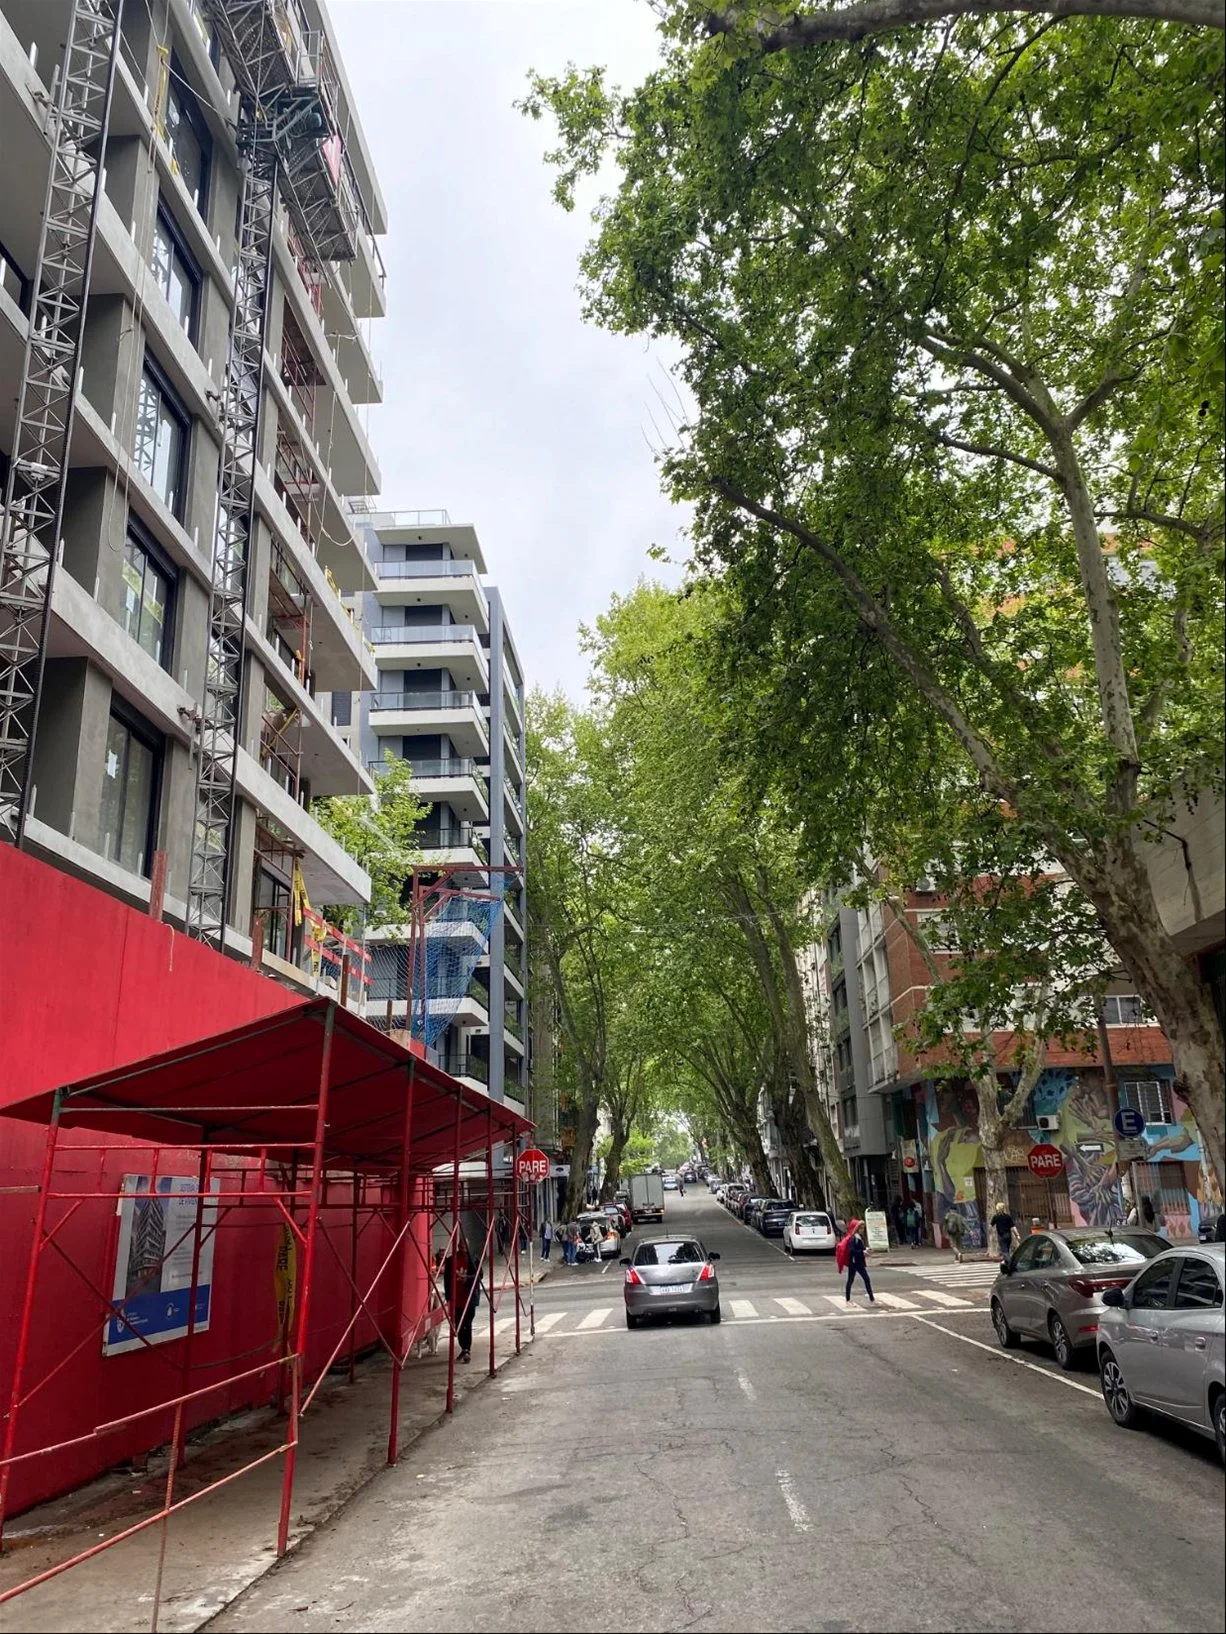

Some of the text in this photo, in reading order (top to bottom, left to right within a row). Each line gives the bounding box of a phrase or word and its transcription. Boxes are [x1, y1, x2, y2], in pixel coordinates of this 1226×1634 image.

[1121, 1111, 1137, 1131] E
[519, 1160, 547, 1173] PARE
[1030, 1154, 1061, 1168] PARE
